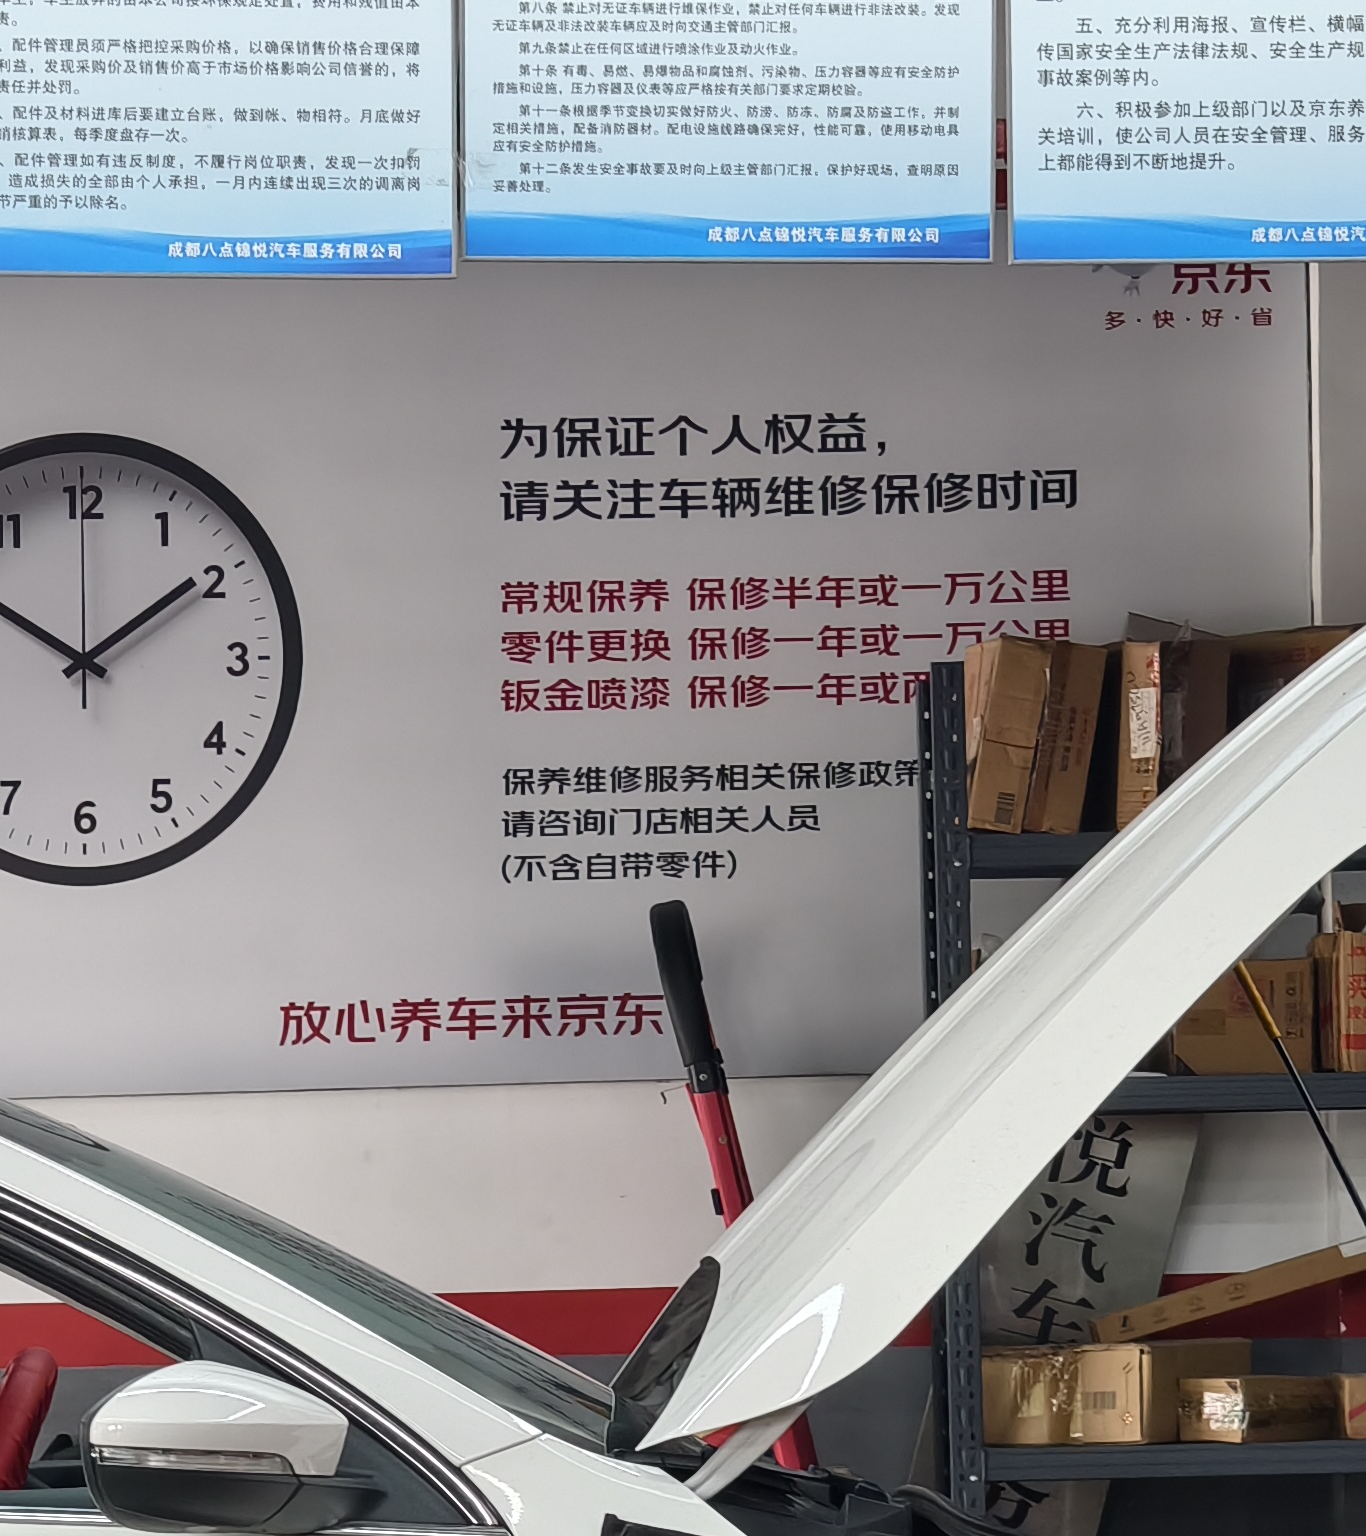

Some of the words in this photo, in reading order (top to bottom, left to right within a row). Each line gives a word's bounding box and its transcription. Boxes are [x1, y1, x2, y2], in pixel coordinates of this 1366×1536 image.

[1037, 151, 1237, 173] 上都能得到不断地提升。
[168, 241, 402, 260] 成都八点锦悦汽车服务有限公司
[707, 226, 940, 244] 成都八点锦悦汽车服务有限公司
[499, 413, 889, 459] 为保证个人权益，
[63, 485, 104, 520] 12
[499, 468, 1079, 522] 请关注车辆维修保修时间
[154, 511, 169, 547] 1
[202, 565, 226, 599] 2
[500, 577, 671, 615] 常规保养
[687, 567, 1072, 612] 保修半年或一万公里
[226, 642, 250, 677] 3
[500, 627, 672, 664] 零件更换
[500, 676, 671, 715] 钣金喷漆
[203, 720, 226, 755] 4
[150, 778, 173, 813] 5
[502, 759, 921, 797] 保养维修服务相关保修政策
[0, 780, 22, 815] 7
[74, 800, 97, 834] 6
[501, 804, 821, 840] 请咨询门店相关人员
[501, 849, 739, 885] (不含自带零件)
[278, 992, 666, 1048] 放心养车来京东
